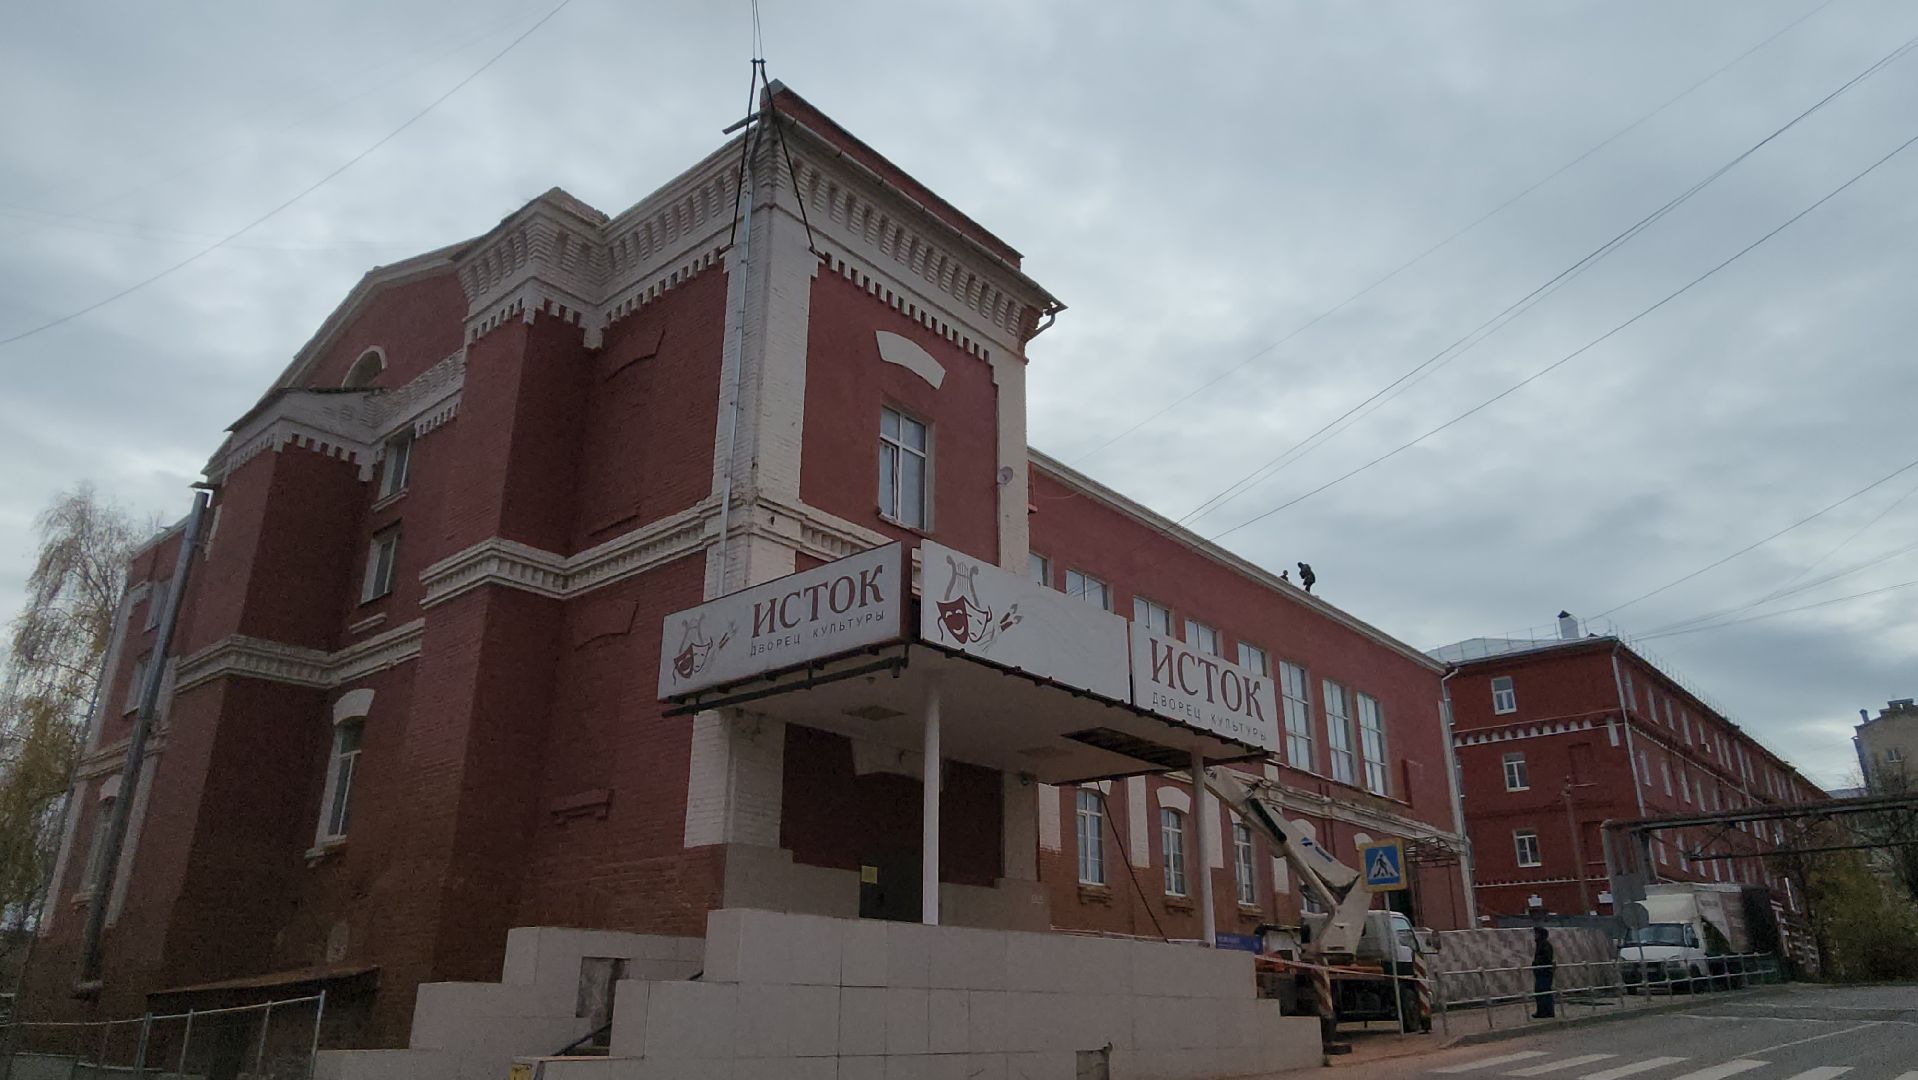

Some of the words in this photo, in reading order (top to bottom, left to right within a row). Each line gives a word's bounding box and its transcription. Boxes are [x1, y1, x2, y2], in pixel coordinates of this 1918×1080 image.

[752, 564, 884, 639] ИСТОК
[750, 633, 801, 657] ДВОРЕЦ
[812, 610, 885, 639] КУЛЬТУРЫ
[1149, 636, 1265, 722] ИСТОК
[1152, 691, 1201, 721] ДВОРЕЦ
